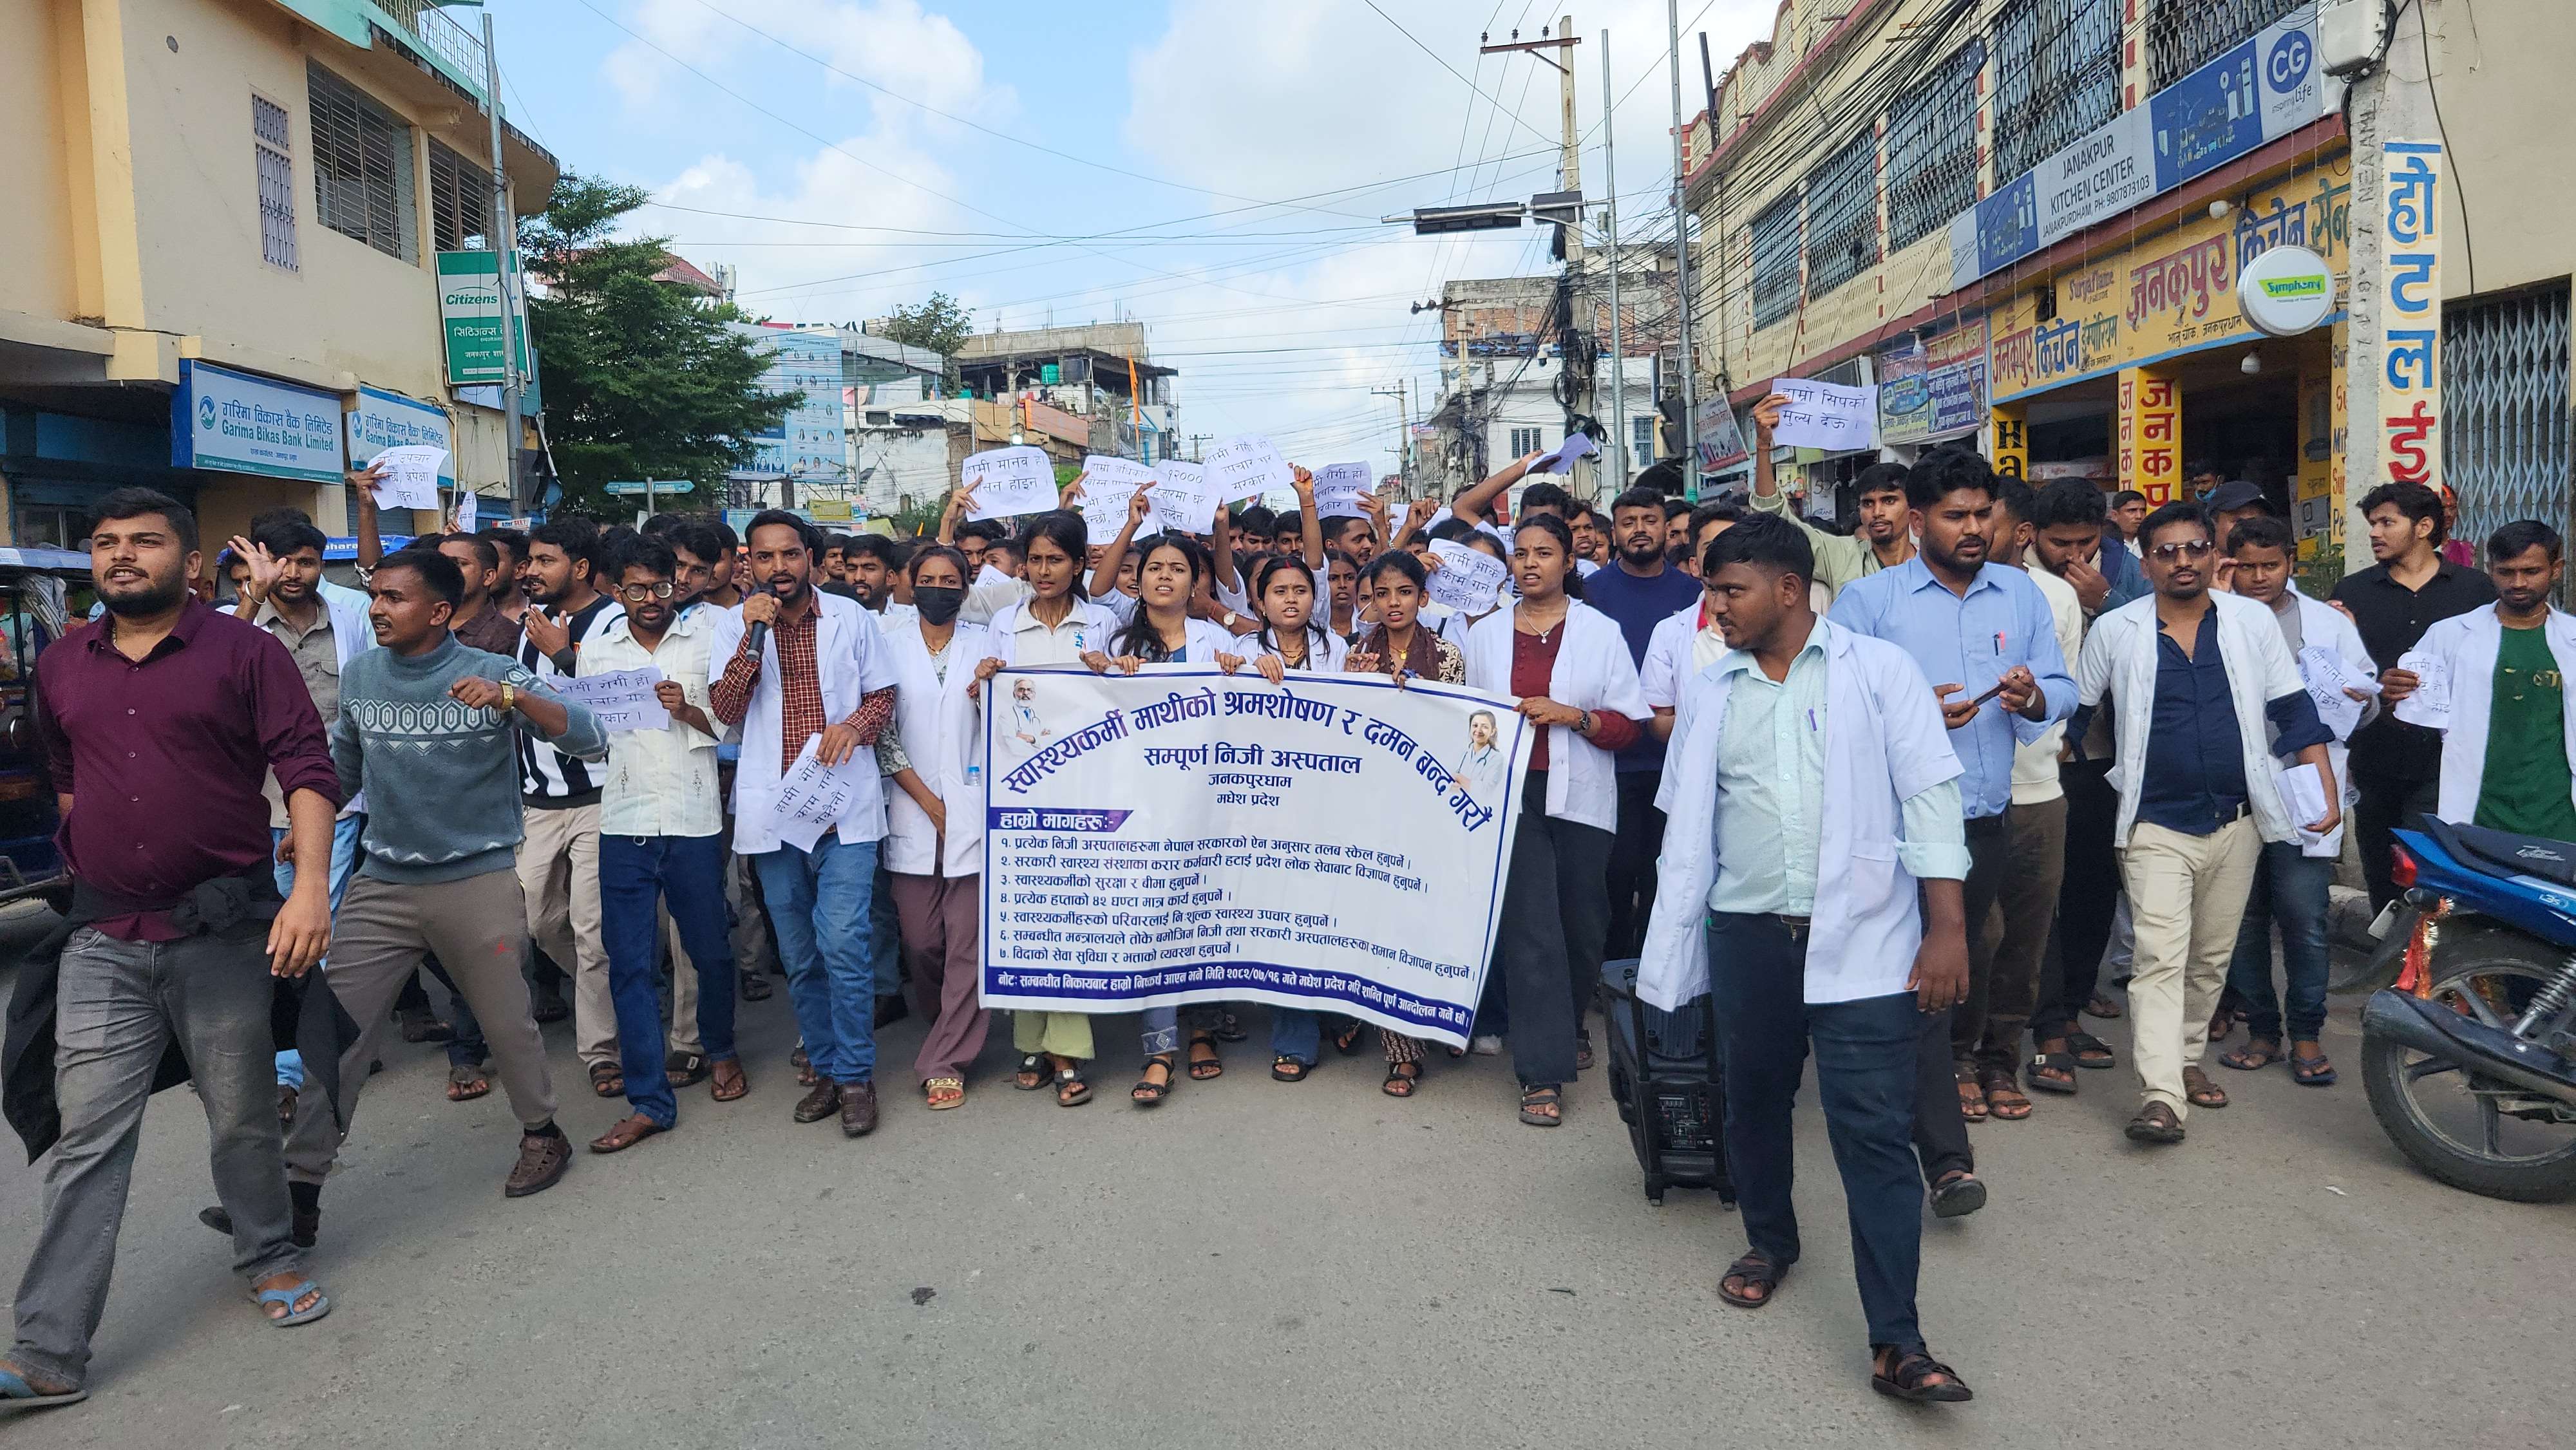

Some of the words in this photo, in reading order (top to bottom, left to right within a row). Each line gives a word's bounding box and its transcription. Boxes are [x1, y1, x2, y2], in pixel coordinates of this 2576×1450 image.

[2272, 41, 2306, 83] CG
[2063, 135, 2114, 180] JANAKPUR
[2050, 178, 2091, 216] KITCHEN
[2093, 156, 2134, 193] CENTER
[2126, 232, 2229, 317] जनकपुर
[2267, 279, 2320, 294] Symphony
[446, 294, 498, 305] Citizens
[222, 399, 251, 421] गरिमा
[254, 404, 284, 427] विकास
[305, 414, 333, 435] लिमिटेड
[222, 419, 254, 440] Garima
[257, 426, 279, 444] Bikas
[282, 430, 302, 447] Bank
[305, 435, 334, 451] Limited
[366, 429, 386, 446] Garima
[1001, 709, 1129, 793] स्वास्थ्यकर्मी
[1130, 686, 1217, 731] माथीको
[1223, 688, 1338, 728] श्रमशोषण
[1342, 710, 1362, 735] र
[1364, 718, 1419, 762] दमन
[1416, 750, 1456, 796] बन्द
[1144, 744, 1209, 771] सम्पूर्ण
[1215, 742, 1264, 765] निजी
[1271, 750, 1363, 774] अस्पताल
[1209, 773, 1293, 790] जनकपुरधाम
[1217, 790, 1246, 805] मधेश
[1251, 792, 1280, 806] प्रदेश
[1000, 809, 1037, 829] हाम्रो
[1015, 835, 1048, 849] प्रत्येक
[1052, 835, 1078, 850] निजी
[1164, 838, 1194, 851] नेपाल
[1197, 835, 1247, 850] सरकारको
[1251, 836, 1267, 849] ऐन
[1271, 839, 1311, 854] अनुसार
[1314, 843, 1341, 856] तलब
[1345, 845, 1373, 860] स्केल
[1014, 854, 1056, 868] सरकारी
[1060, 858, 1100, 869] स्वास्थ्य
[1103, 857, 1148, 870] संस्थाका
[1151, 860, 1180, 871] करार
[1183, 853, 1222, 869] कर्मचारी
[1225, 854, 1253, 867] हटाई
[1256, 854, 1282, 868] प्रदेश
[1285, 856, 1311, 871] लोक
[1314, 858, 1352, 876] सेवाबाट
[1355, 863, 1390, 883] विज्ञापन
[1015, 873, 1091, 887] स्वास्थ्यकर्मीको
[1095, 876, 1126, 890] सुरक्षा
[1130, 878, 1139, 889] र
[1142, 875, 1166, 889] बीमा
[1014, 890, 1048, 905] प्रत्येक
[1050, 892, 1089, 906] हप्ताको
[1111, 896, 1139, 907] घण्टा
[1142, 896, 1164, 908] मात्र
[1168, 892, 1189, 906] कार्य
[1112, 910, 1169, 926] परिवारलाई
[1215, 909, 1254, 919] स्वास्थ्य
[1257, 909, 1292, 923] उपचार
[1013, 928, 1063, 942] सम्बन्धीत
[1065, 931, 1125, 945] मन्त्रालयले
[1130, 932, 1153, 945] तोके
[1156, 927, 1193, 943] बमोजिम
[1197, 924, 1222, 939] निजी
[1226, 926, 1246, 937] तथा
[1250, 927, 1291, 941] सरकारी
[1371, 943, 1396, 961] समान
[1399, 948, 1433, 972] विज्ञापन
[1013, 945, 1048, 961] विदाको
[1052, 947, 1072, 961] सेवा
[1075, 948, 1108, 965] सुविधा
[1111, 952, 1119, 963] र
[1122, 948, 1157, 963] भत्ताको
[1160, 946, 1195, 959] व्यवस्था
[1063, 974, 1108, 990] निकायबाट
[1110, 975, 1132, 991] हाम्रो
[1163, 972, 1186, 985] आएन
[1188, 967, 1203, 981] भने
[1206, 966, 1224, 979] मिति
[1282, 971, 1296, 985] गते
[1298, 975, 1321, 989] मधेश
[1324, 975, 1346, 990] प्रदेश
[1397, 998, 1436, 1017] आन्दोलन
